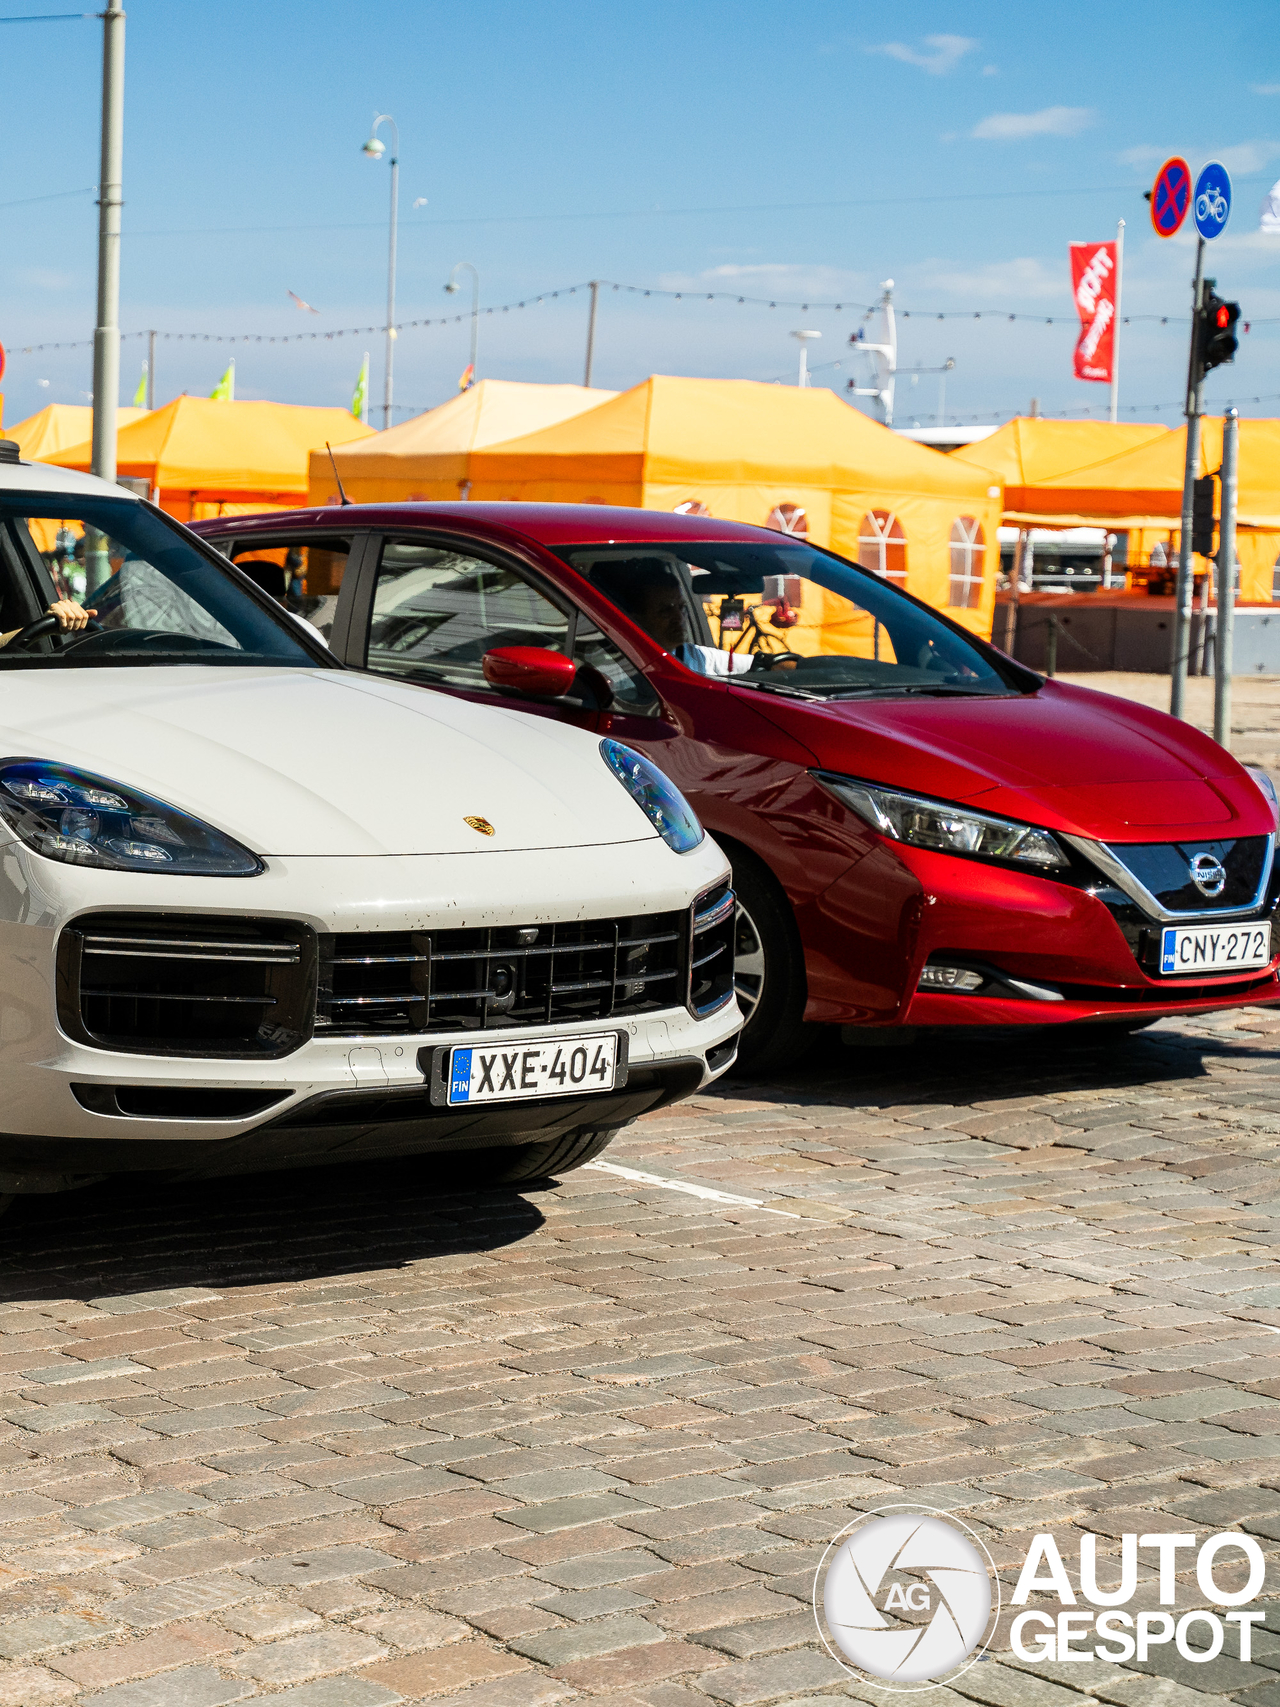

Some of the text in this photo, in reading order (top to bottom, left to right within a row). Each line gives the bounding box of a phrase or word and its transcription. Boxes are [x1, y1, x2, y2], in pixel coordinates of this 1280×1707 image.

[1180, 931, 1266, 963] CNY-272
[1163, 954, 1175, 964] FIN
[476, 1044, 608, 1094] XXE-404
[452, 1080, 469, 1093] FIN
